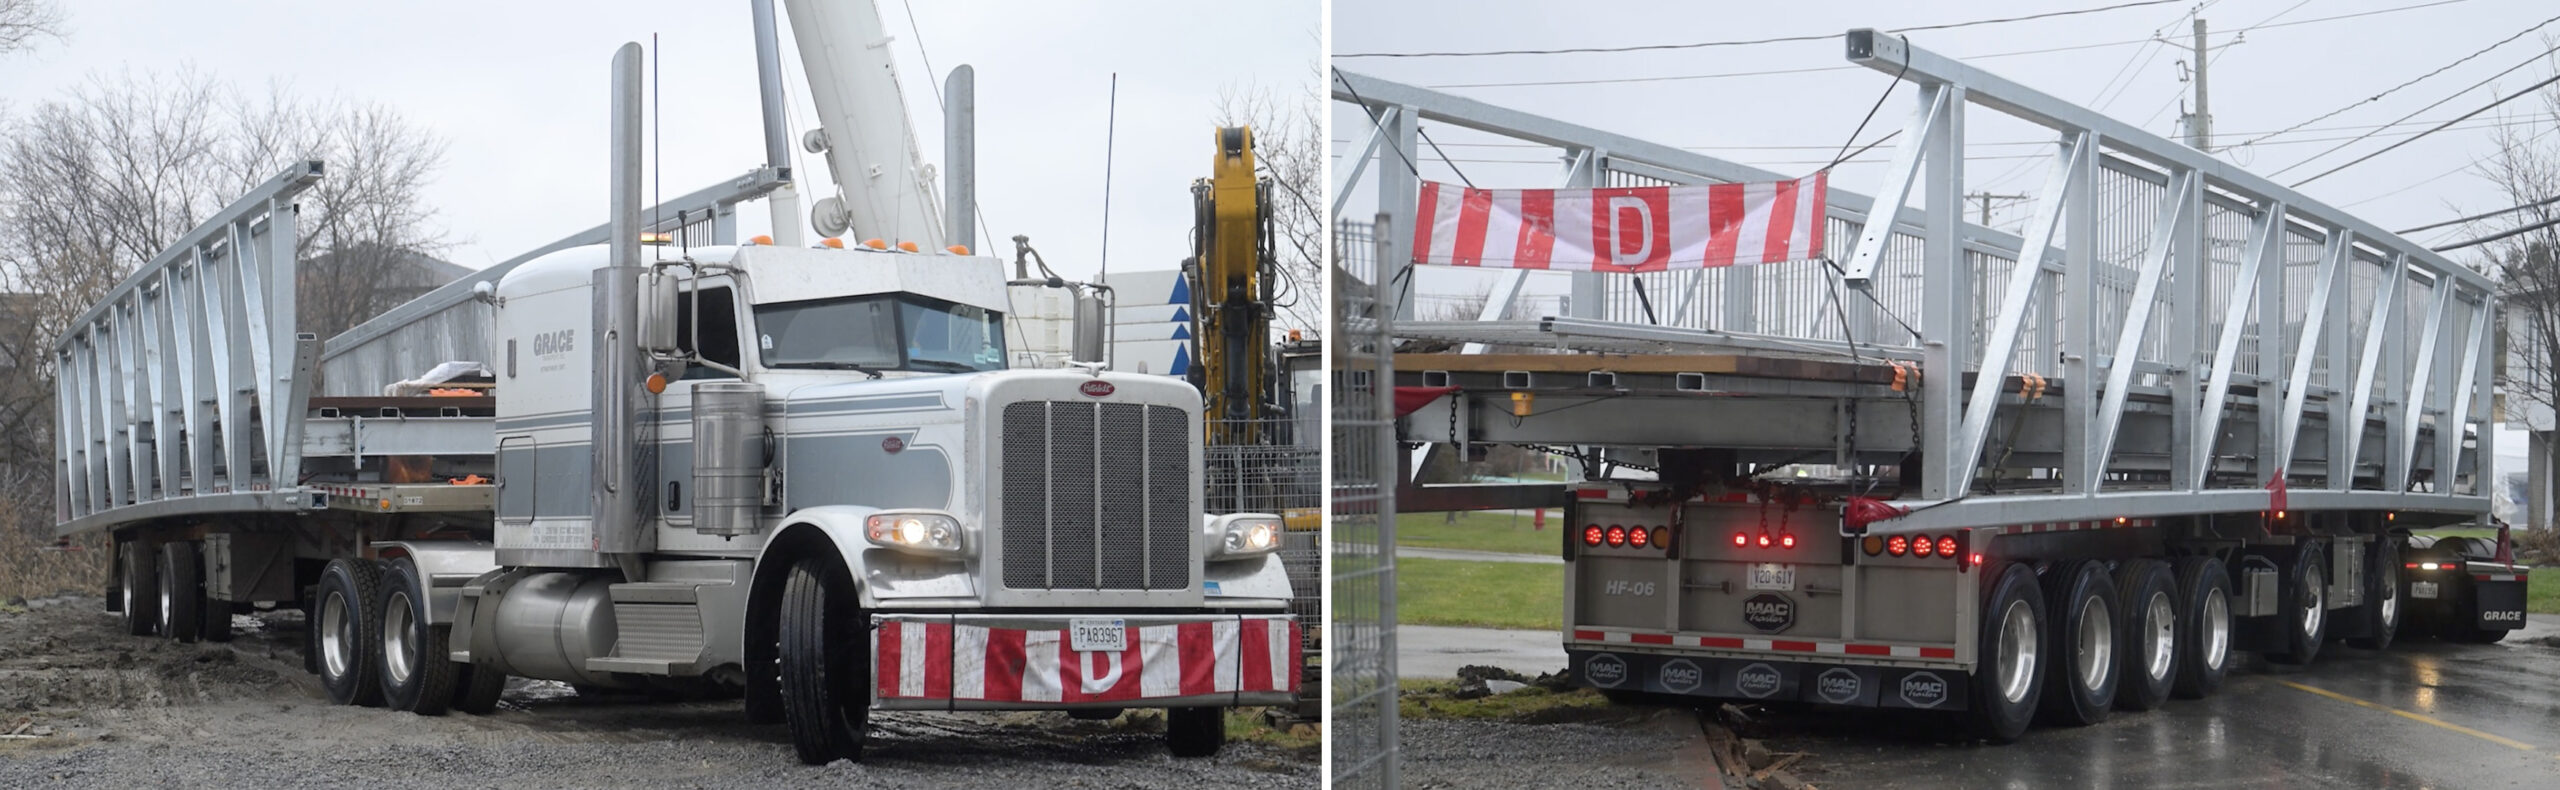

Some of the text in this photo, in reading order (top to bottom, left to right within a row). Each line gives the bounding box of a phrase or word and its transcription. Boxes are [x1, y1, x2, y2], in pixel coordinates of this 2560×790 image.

[1609, 196, 1653, 265] D
[533, 329, 574, 356] GRACE
[1605, 580, 1655, 596] HF-06
[1745, 602, 1789, 616] MAC
[2483, 611, 2521, 621] GRACE
[1079, 627, 1123, 643] PA83967
[1080, 651, 1123, 694] D
[1591, 662, 1622, 674] MAC
[1664, 668, 1698, 680] MAC
[1742, 673, 1776, 684] MAC
[1822, 677, 1857, 689] MAC
[1905, 681, 1942, 693] MAC
